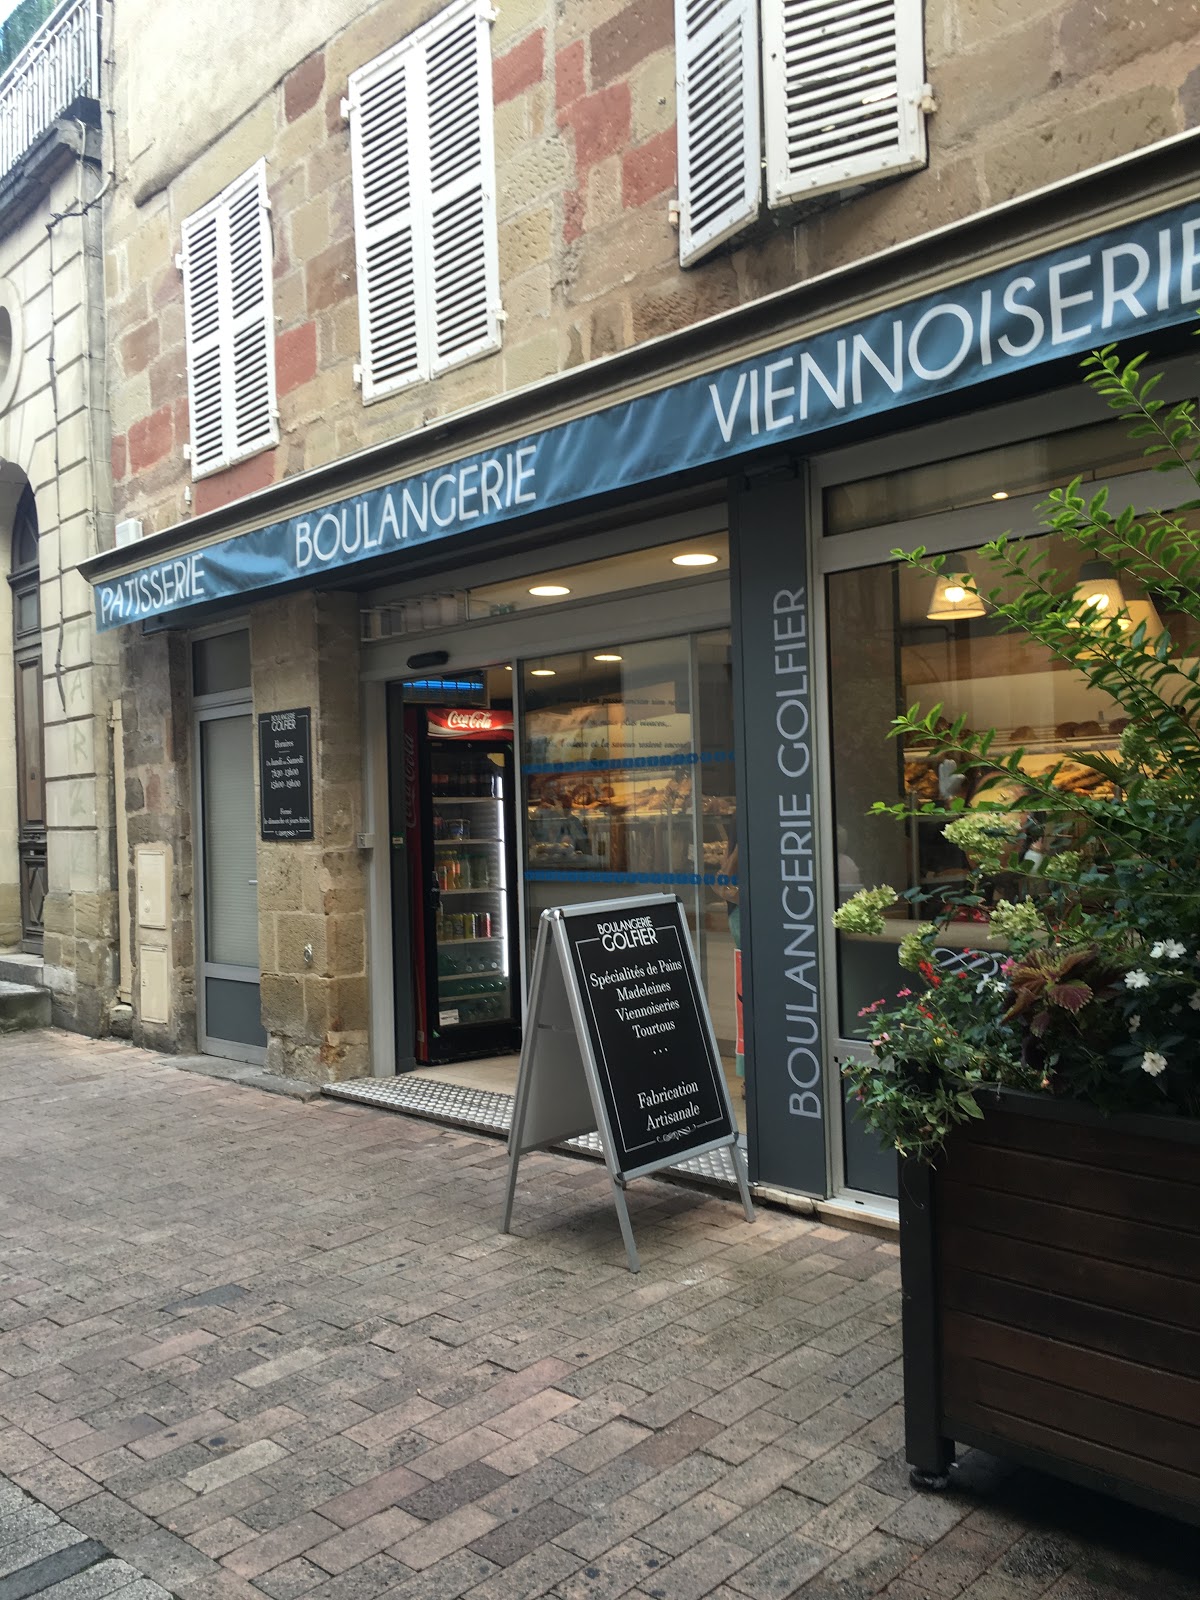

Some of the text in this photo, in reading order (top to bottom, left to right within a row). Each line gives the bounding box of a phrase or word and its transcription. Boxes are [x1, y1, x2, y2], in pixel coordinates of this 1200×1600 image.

[295, 445, 537, 569] BOULANGERIE
[101, 553, 205, 623] PATISSERIE
[271, 719, 297, 731] GOLFIER
[274, 739, 294, 748] Horaires
[773, 587, 822, 1120] BOULANGERIE GOLFIER
[597, 916, 653, 934] BOULANGERIE
[602, 928, 658, 952] GOLFIER
[589, 958, 683, 990] Spécialités de Pains
[616, 980, 672, 1002] Madeleines
[615, 998, 680, 1022] Viennoiseries
[632, 1019, 676, 1039] Tourtous
[637, 1081, 699, 1109] Fabrication
[646, 1101, 701, 1131] Artisanale
